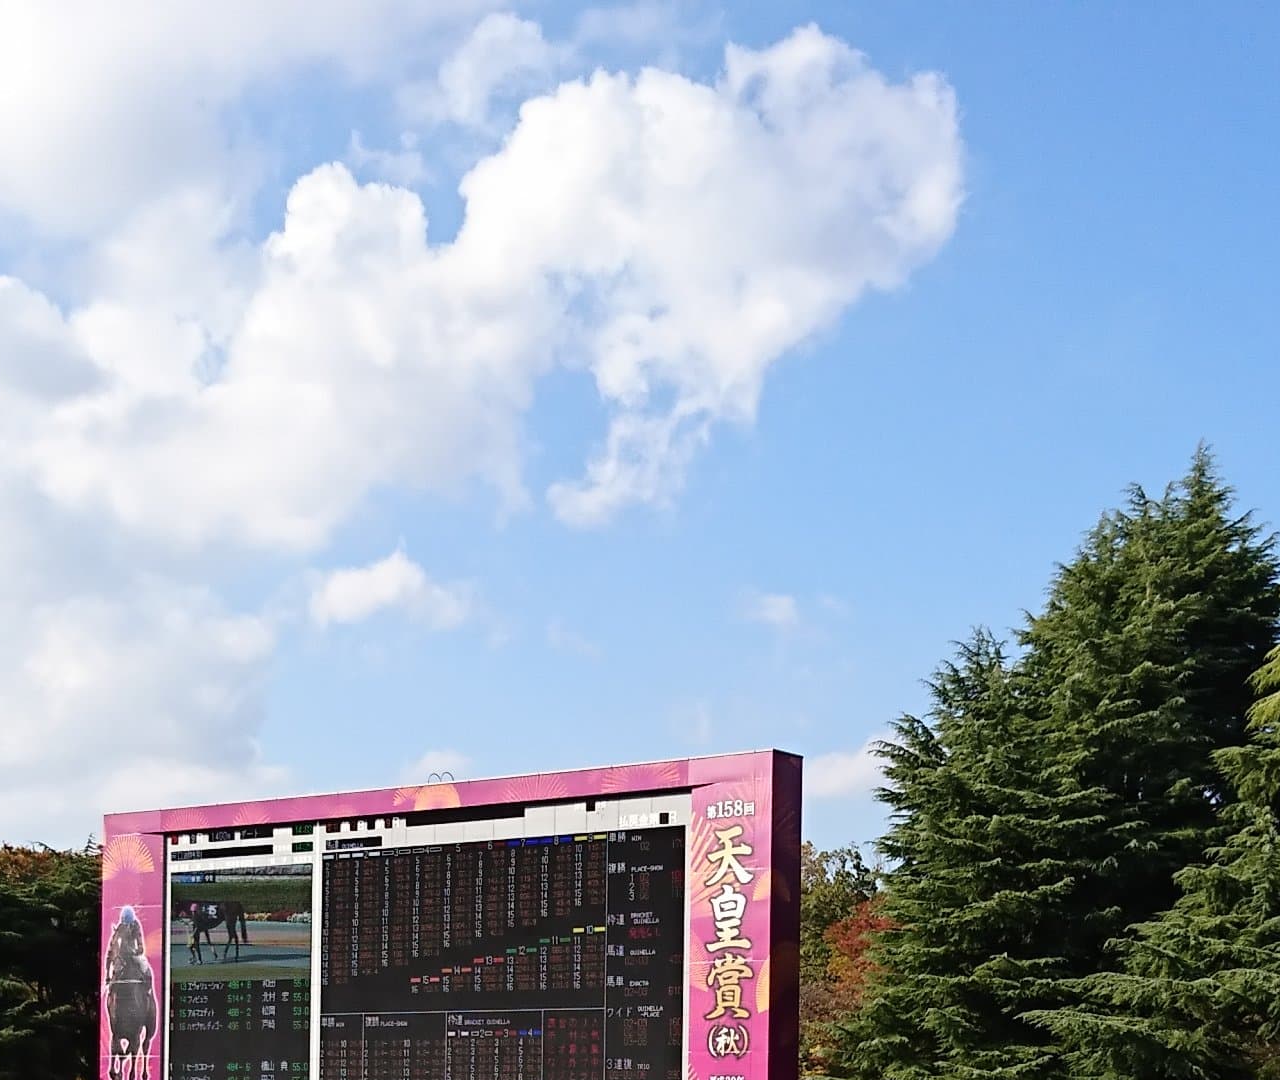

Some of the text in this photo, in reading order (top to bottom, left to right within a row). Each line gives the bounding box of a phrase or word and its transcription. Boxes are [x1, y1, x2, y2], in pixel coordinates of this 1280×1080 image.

[707, 800, 755, 818] 第158回
[704, 824, 755, 1021] 天皇賞
[607, 976, 624, 986] 馬単
[607, 1007, 633, 1017] ワイド
[708, 1025, 749, 1057] (秋)
[606, 1059, 632, 1069] 3連複
